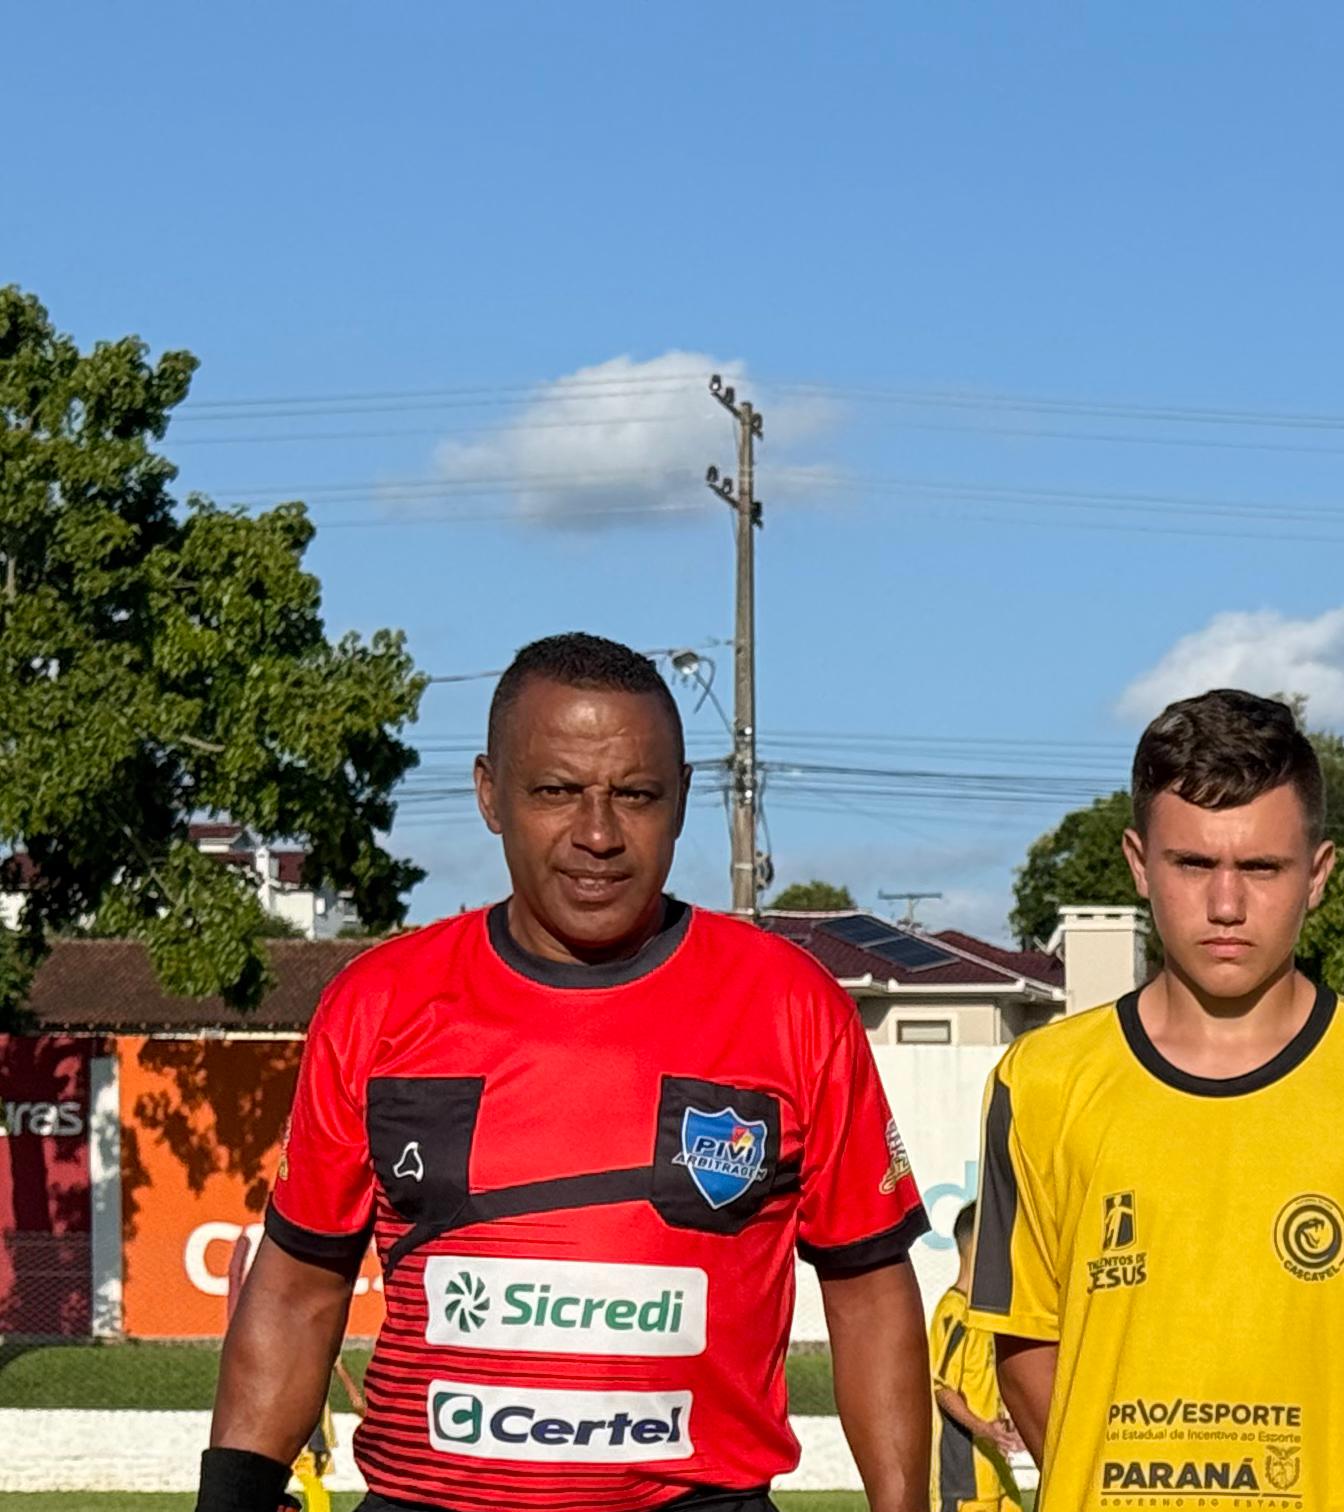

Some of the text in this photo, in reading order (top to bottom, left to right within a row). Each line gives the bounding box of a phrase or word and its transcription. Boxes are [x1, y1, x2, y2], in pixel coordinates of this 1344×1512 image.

[501, 1283, 684, 1333] Sicredi
[490, 1406, 682, 1445] Certel
[1106, 1429, 1301, 1443] Lei Estadual de Incentivo ao Esporte
[1103, 1458, 1260, 1490] PARANÁ
